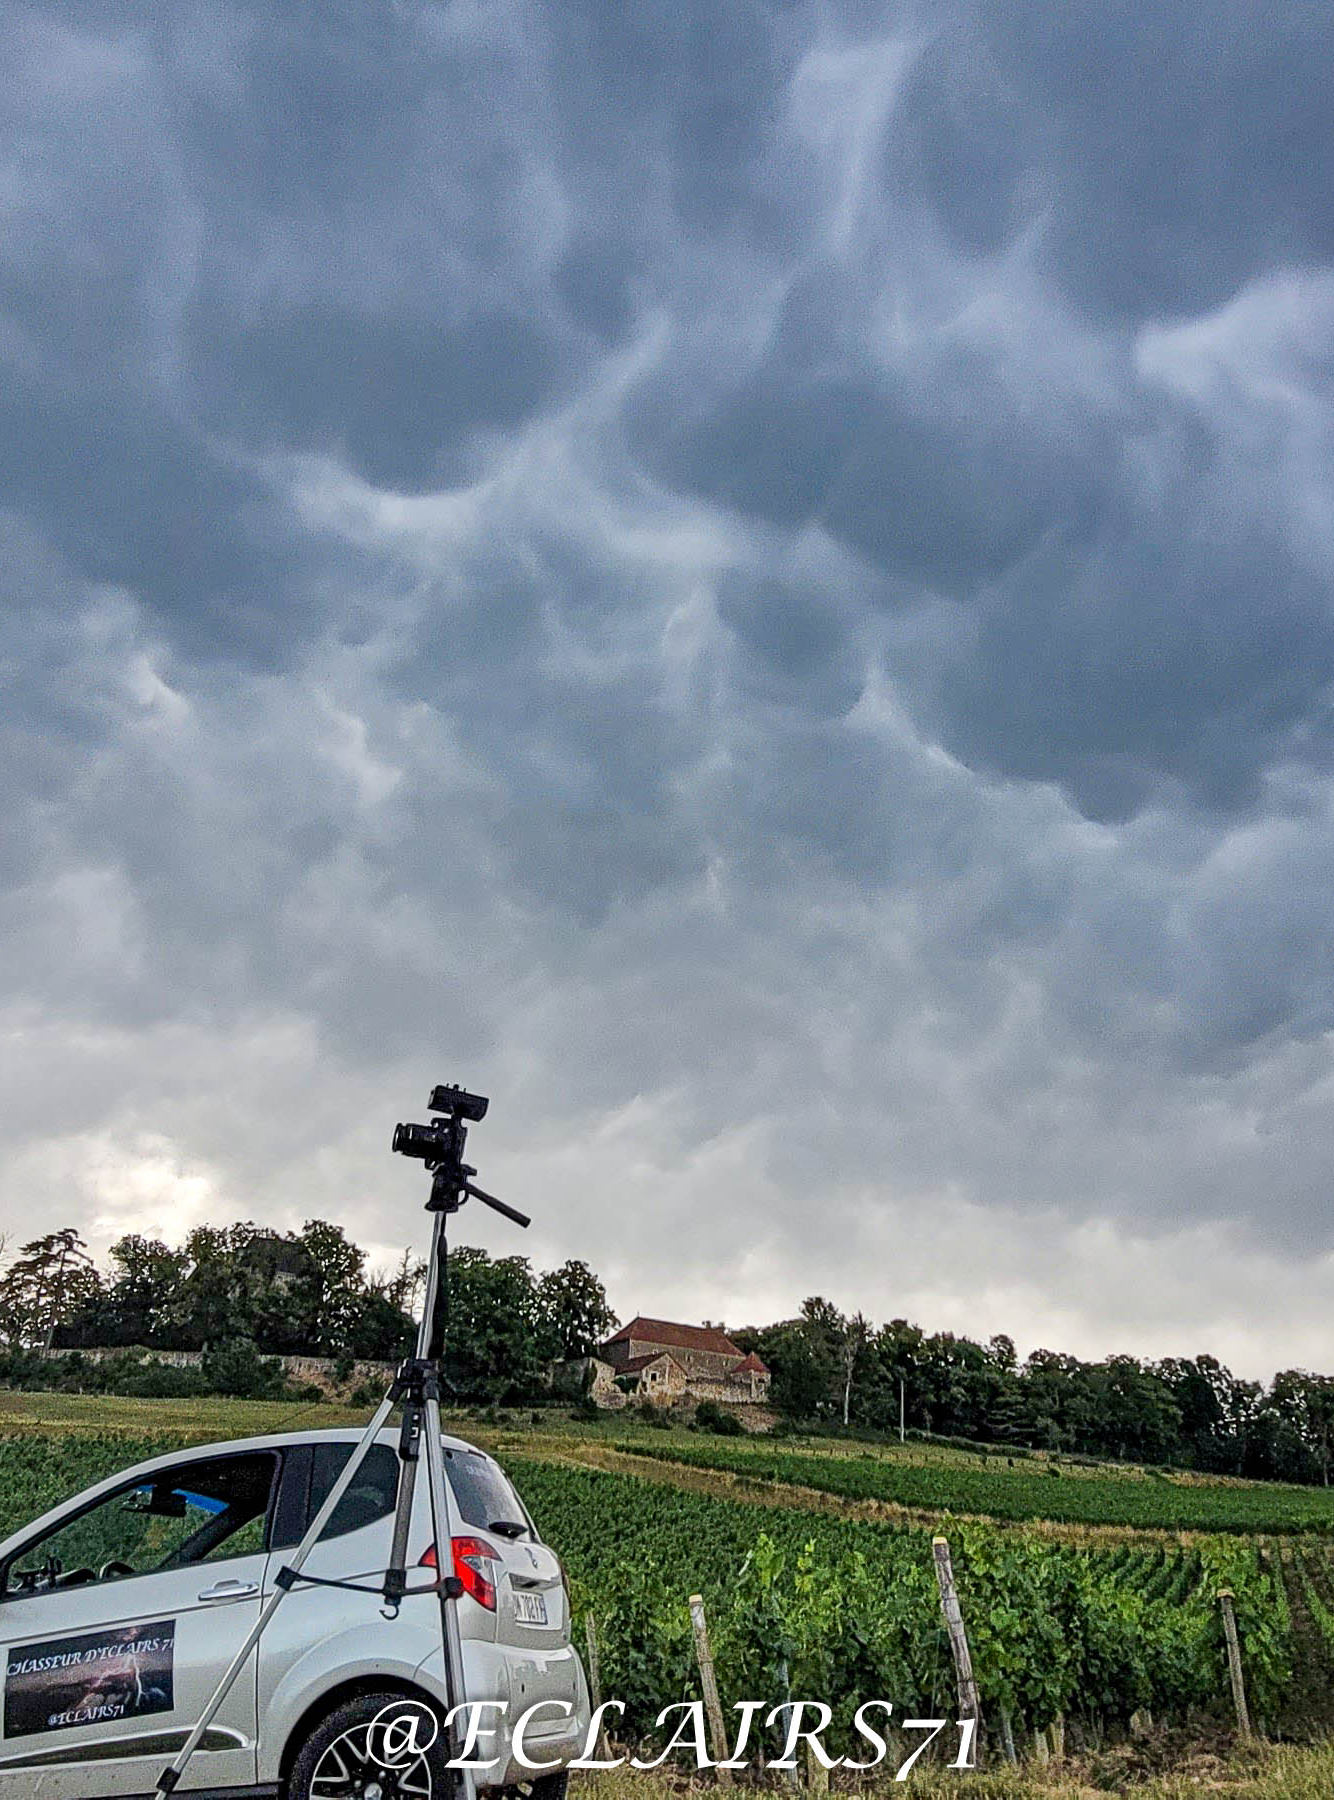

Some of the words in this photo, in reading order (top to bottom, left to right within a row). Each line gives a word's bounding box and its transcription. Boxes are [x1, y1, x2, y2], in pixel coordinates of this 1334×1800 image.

[7, 1651, 82, 1676] CHASSEUR
[85, 1638, 160, 1663] D'ECLAIRS
[48, 1704, 124, 1726] @ECLAIRS71
